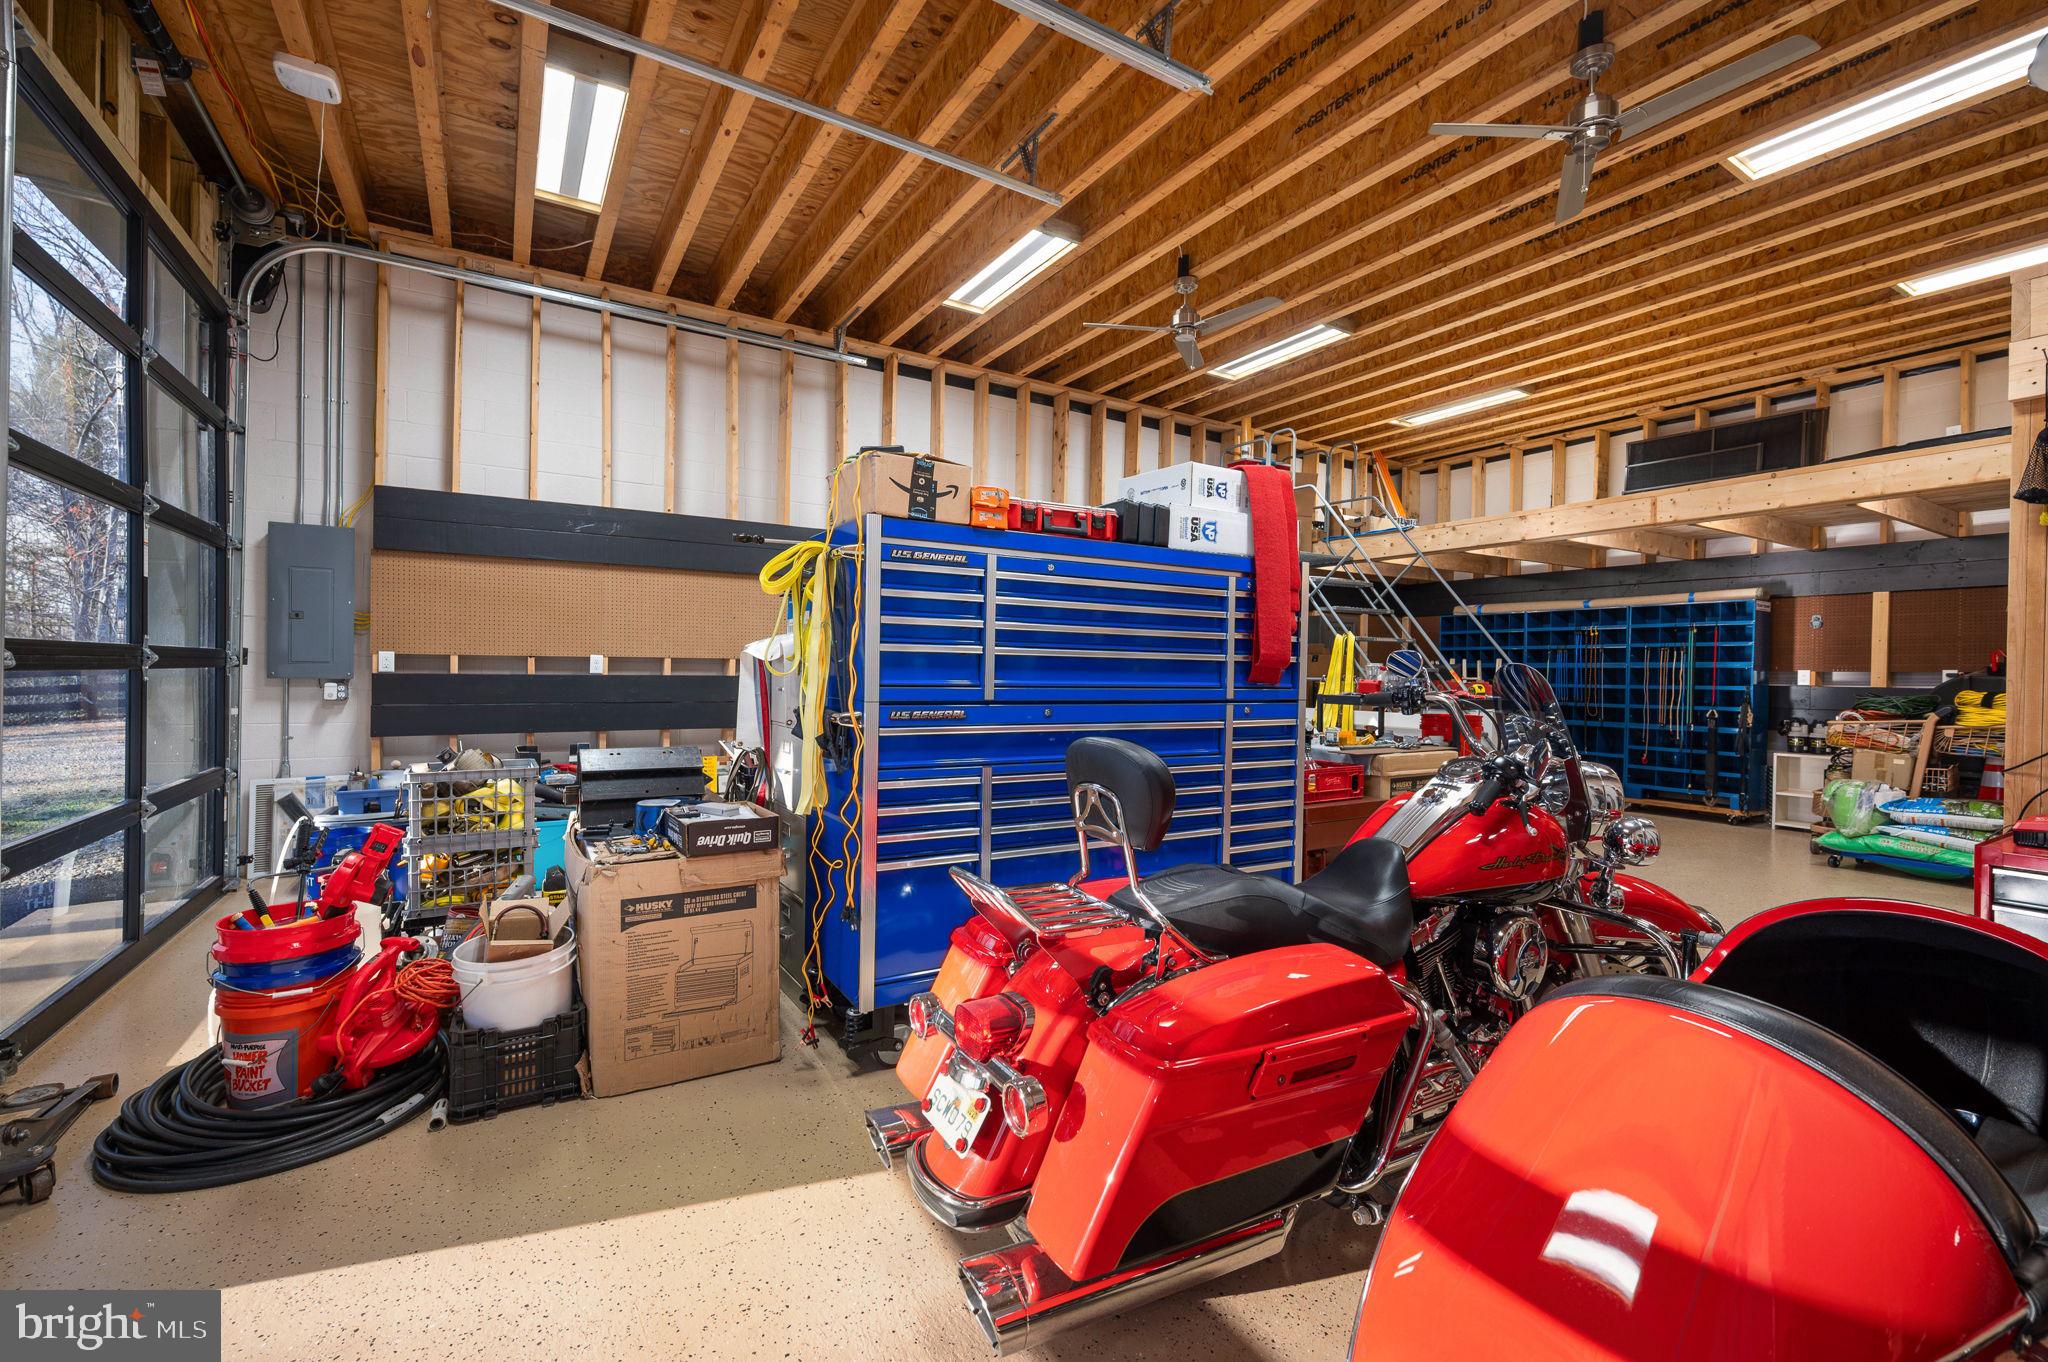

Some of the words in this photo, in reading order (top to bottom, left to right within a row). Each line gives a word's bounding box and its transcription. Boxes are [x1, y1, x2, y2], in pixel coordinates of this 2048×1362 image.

[1455, 11, 1475, 31] BLI
[1311, 12, 1356, 52] BlueLinx
[1368, 52, 1414, 89] BlueLinx
[1206, 477, 1214, 498] USA
[1190, 516, 1200, 543] USA
[913, 551, 968, 563] GENERAL
[911, 710, 967, 720] GENERAL
[697, 834, 726, 847] Drive
[726, 830, 752, 846] Quik
[696, 894, 720, 903] STAINLESS
[720, 892, 733, 900] STEEL
[635, 899, 673, 912] HUSKY
[235, 1065, 266, 1079] PAINT
[232, 1078, 272, 1092] BUCKET
